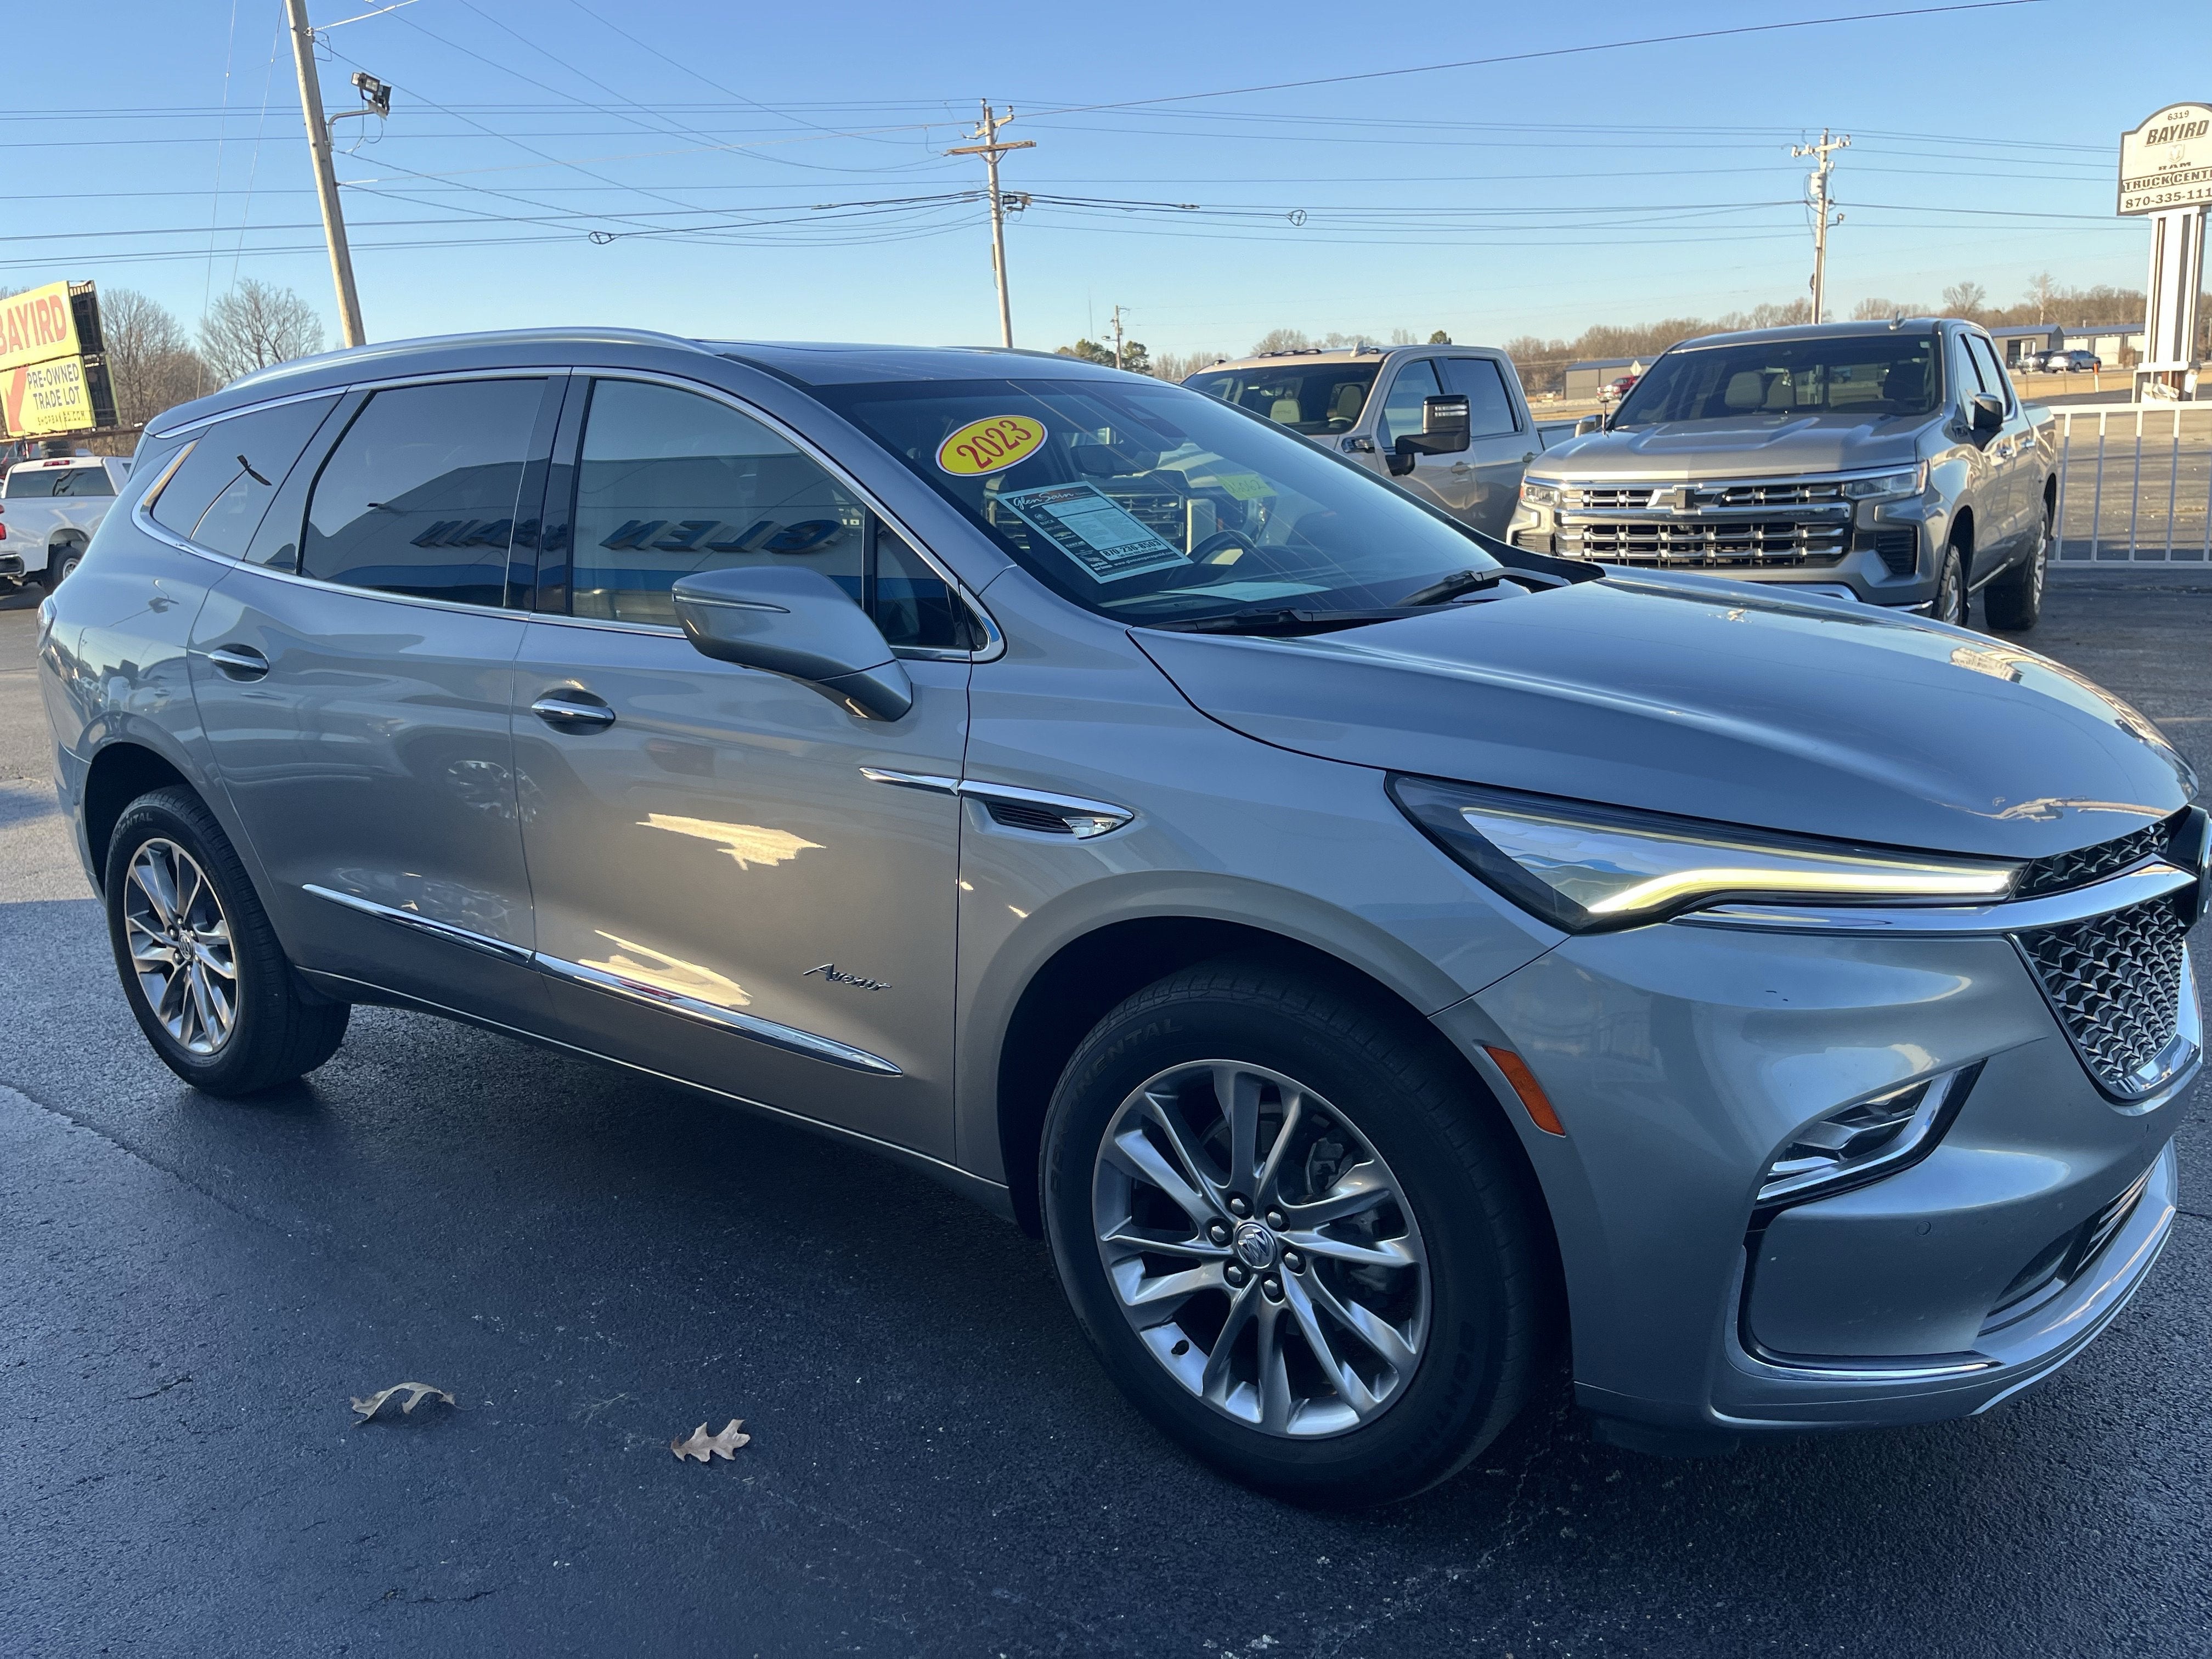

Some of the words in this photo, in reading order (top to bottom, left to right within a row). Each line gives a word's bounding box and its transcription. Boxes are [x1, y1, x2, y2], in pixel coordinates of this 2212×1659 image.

[2168, 110, 2190, 120] 6319
[2146, 120, 2209, 145] BAYIRD
[2159, 162, 2191, 171] RAM
[2125, 175, 2170, 190] TRUCK
[27, 363, 79, 390] PRE-OWNED
[33, 388, 63, 410] TRADE
[63, 386, 81, 405] LOT
[956, 420, 1031, 469] 2023
[1013, 496, 1042, 510] Glen
[1039, 492, 1074, 503] Sain
[803, 963, 893, 991] Avenir
